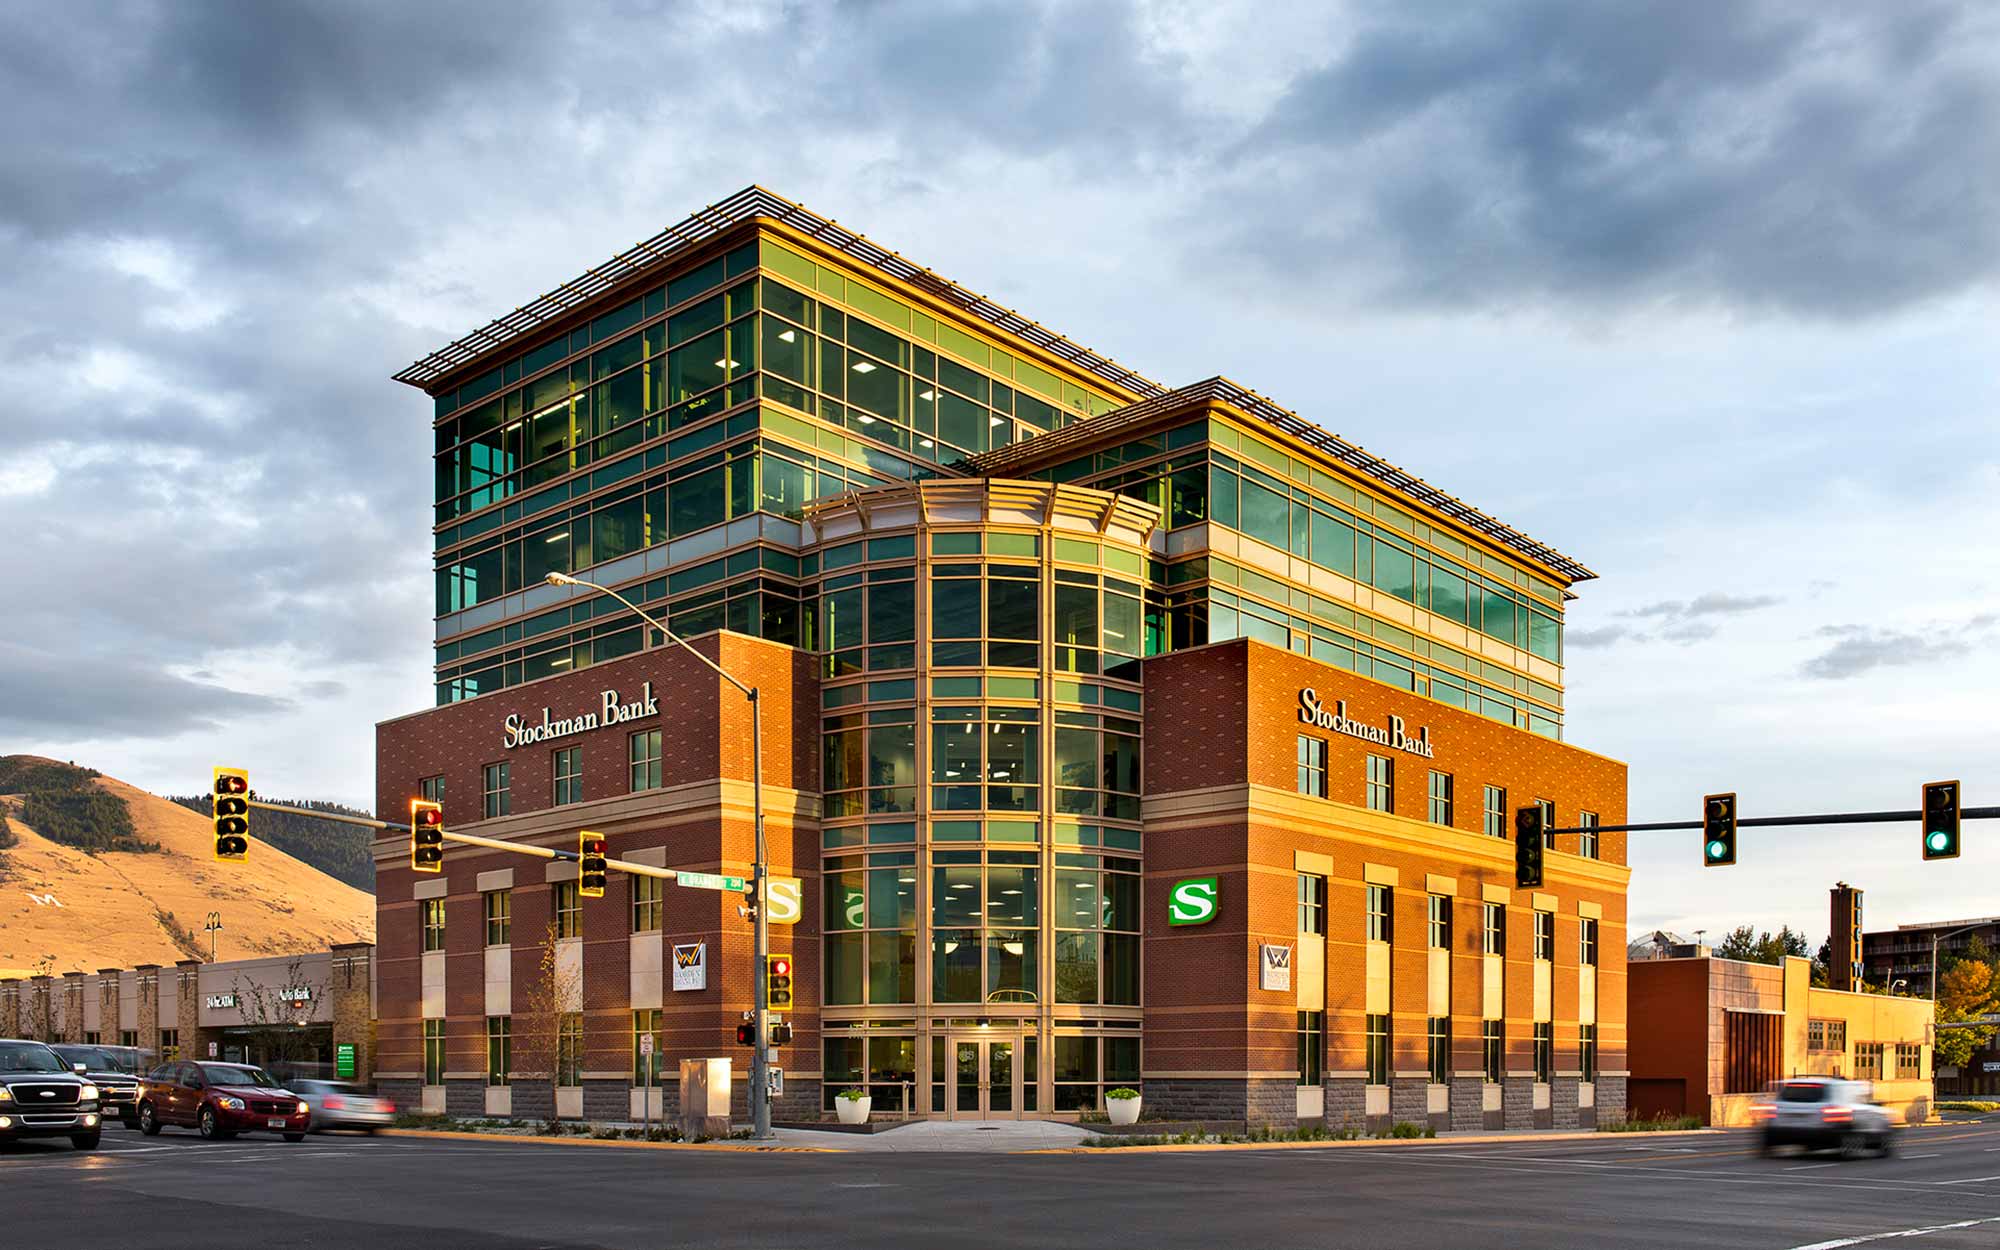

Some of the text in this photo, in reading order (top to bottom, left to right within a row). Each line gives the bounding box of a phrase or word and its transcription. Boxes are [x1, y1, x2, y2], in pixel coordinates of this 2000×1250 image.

[504, 681, 658, 748] Stockman Bank
[1298, 687, 1434, 759] Stockman Bank
[25, 892, 65, 908] M
[767, 882, 802, 919] S
[1169, 884, 1216, 920] S
